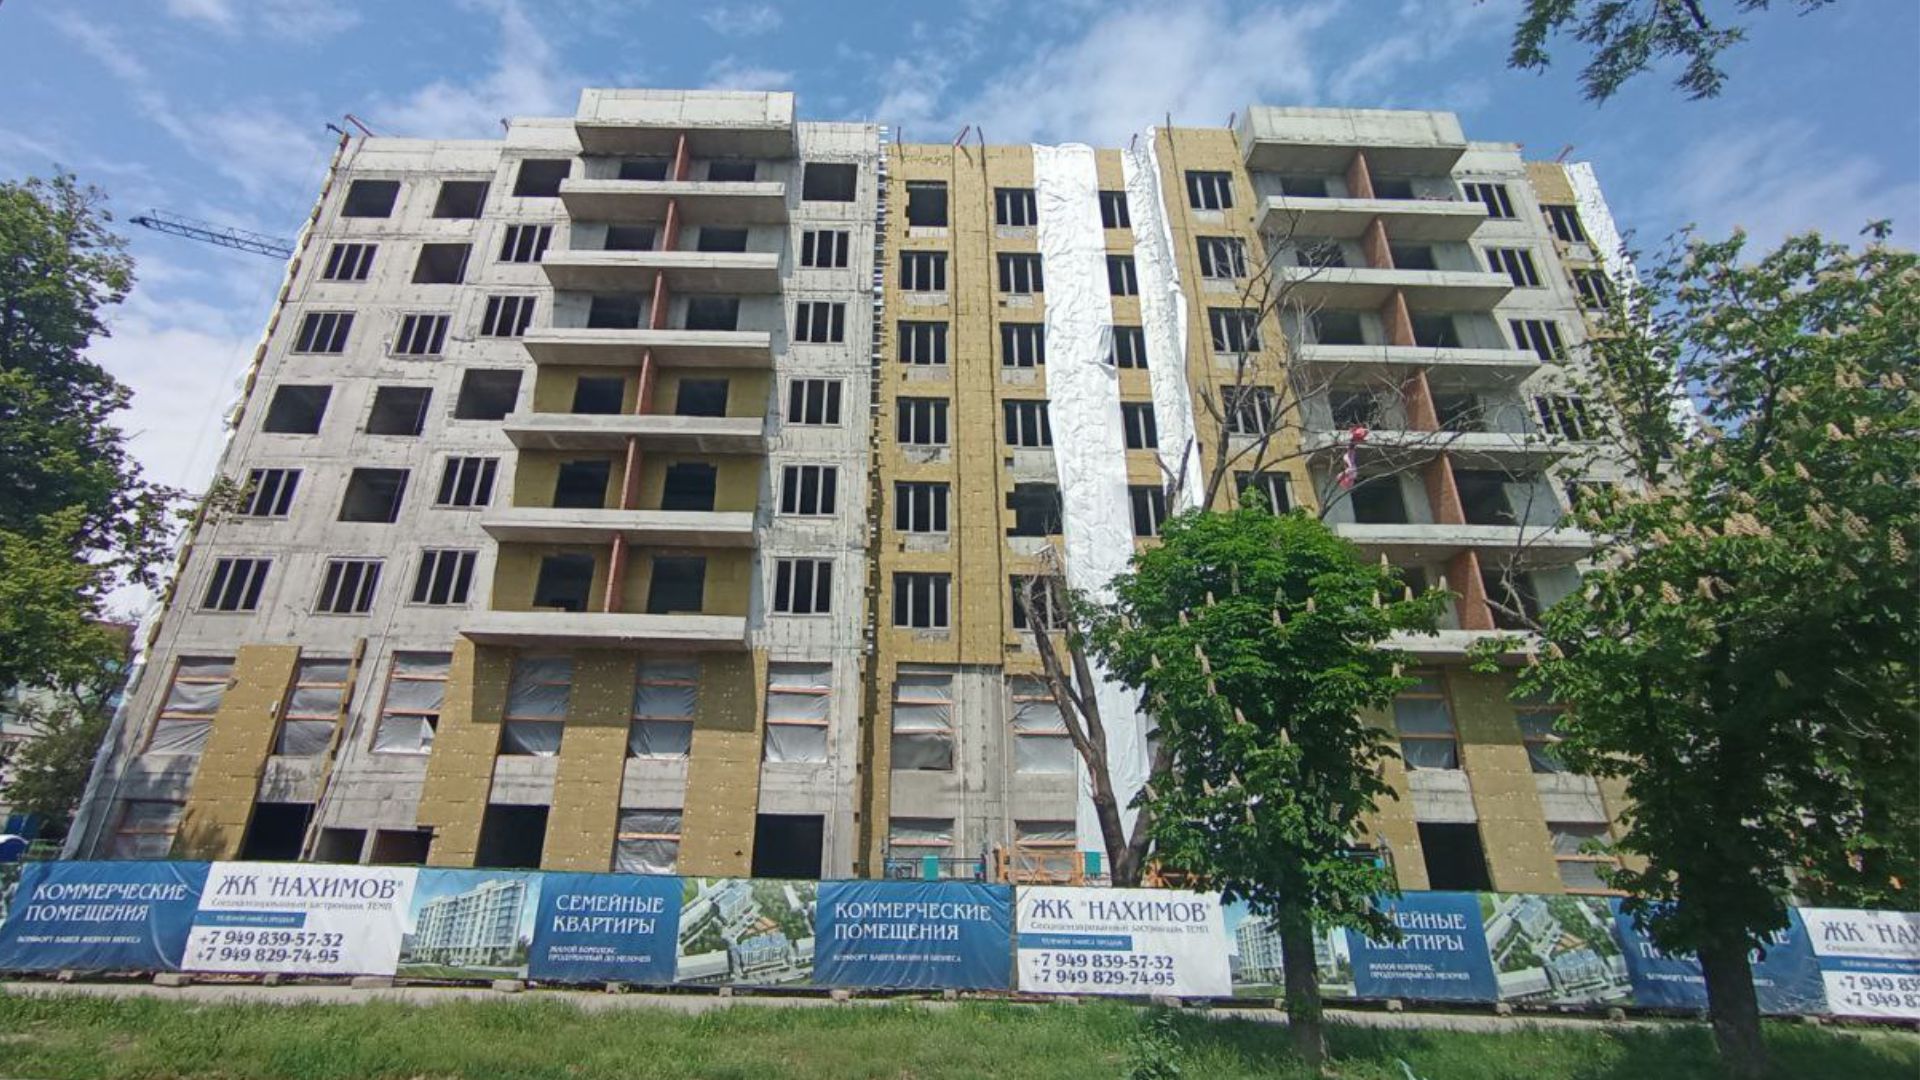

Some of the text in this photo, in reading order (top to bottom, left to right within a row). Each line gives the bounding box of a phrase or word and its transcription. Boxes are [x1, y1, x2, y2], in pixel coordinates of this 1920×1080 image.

[32, 883, 188, 901] КОММЕРЧЕСКИЕ
[215, 875, 404, 899] ЖК "НАХИМОВ"
[25, 904, 149, 923] ПОМЕЩЕНИЯ
[555, 894, 665, 914] СЕМЕЙНЫЕ
[834, 902, 992, 921] КОММЕРЧЕСКИЕ
[1031, 899, 1211, 922] ЖК "НАХИМОВ"
[552, 915, 656, 934] КВАРТИРЫ
[1384, 911, 1467, 930] МЕЙНЫЕ
[200, 931, 344, 947] +7 949 839-57-32
[834, 923, 960, 942] ПОМЕЩЕНИЯ
[1820, 922, 1864, 942] ЖК
[197, 947, 340, 964] +7 949 829-74-95
[1032, 953, 1174, 970] +7 949 839-57-32
[1033, 969, 1175, 986] +7 949 829-74-95
[1839, 975, 1856, 989] +7
[1860, 976, 1894, 991] 949
[1845, 992, 1862, 1006] +7
[1866, 992, 1901, 1007] 949
